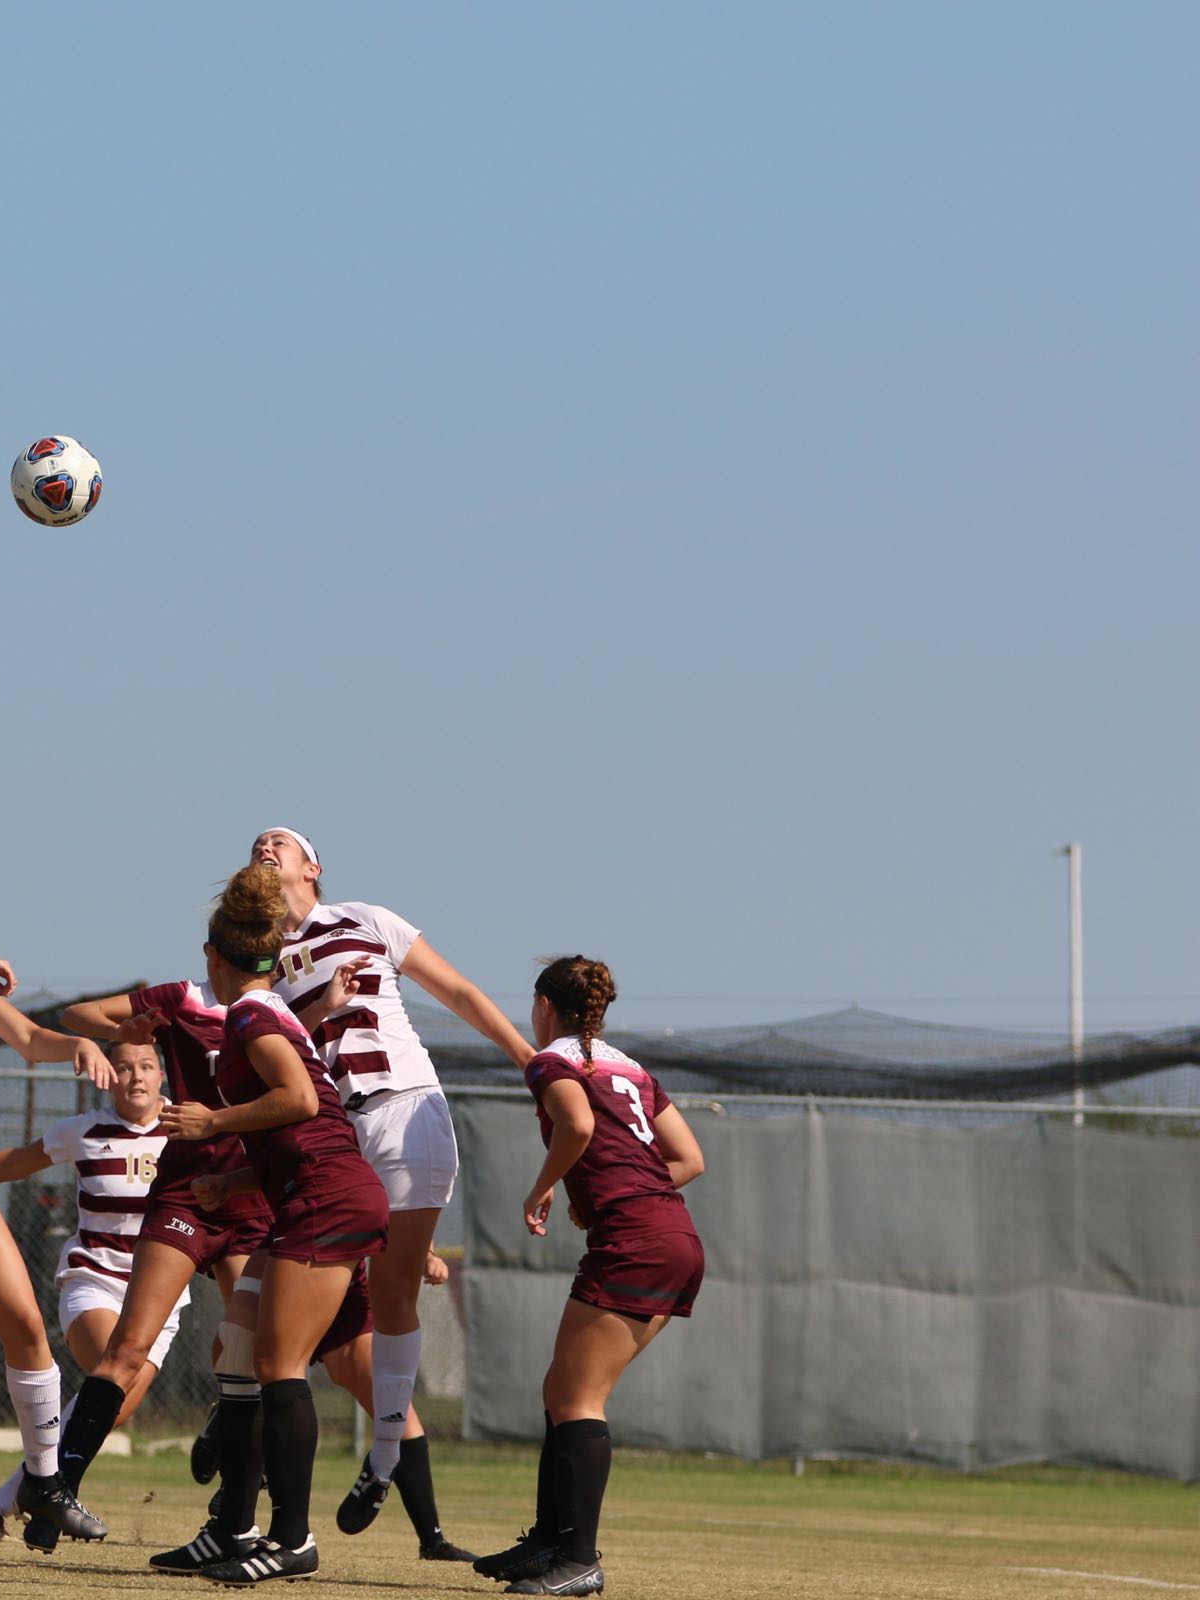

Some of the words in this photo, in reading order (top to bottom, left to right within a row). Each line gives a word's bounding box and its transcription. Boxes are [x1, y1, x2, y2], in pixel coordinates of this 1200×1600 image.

[282, 945, 316, 985] 11
[611, 1074, 654, 1146] 3
[126, 1152, 158, 1184] 16
[171, 1217, 196, 1236] TWU
